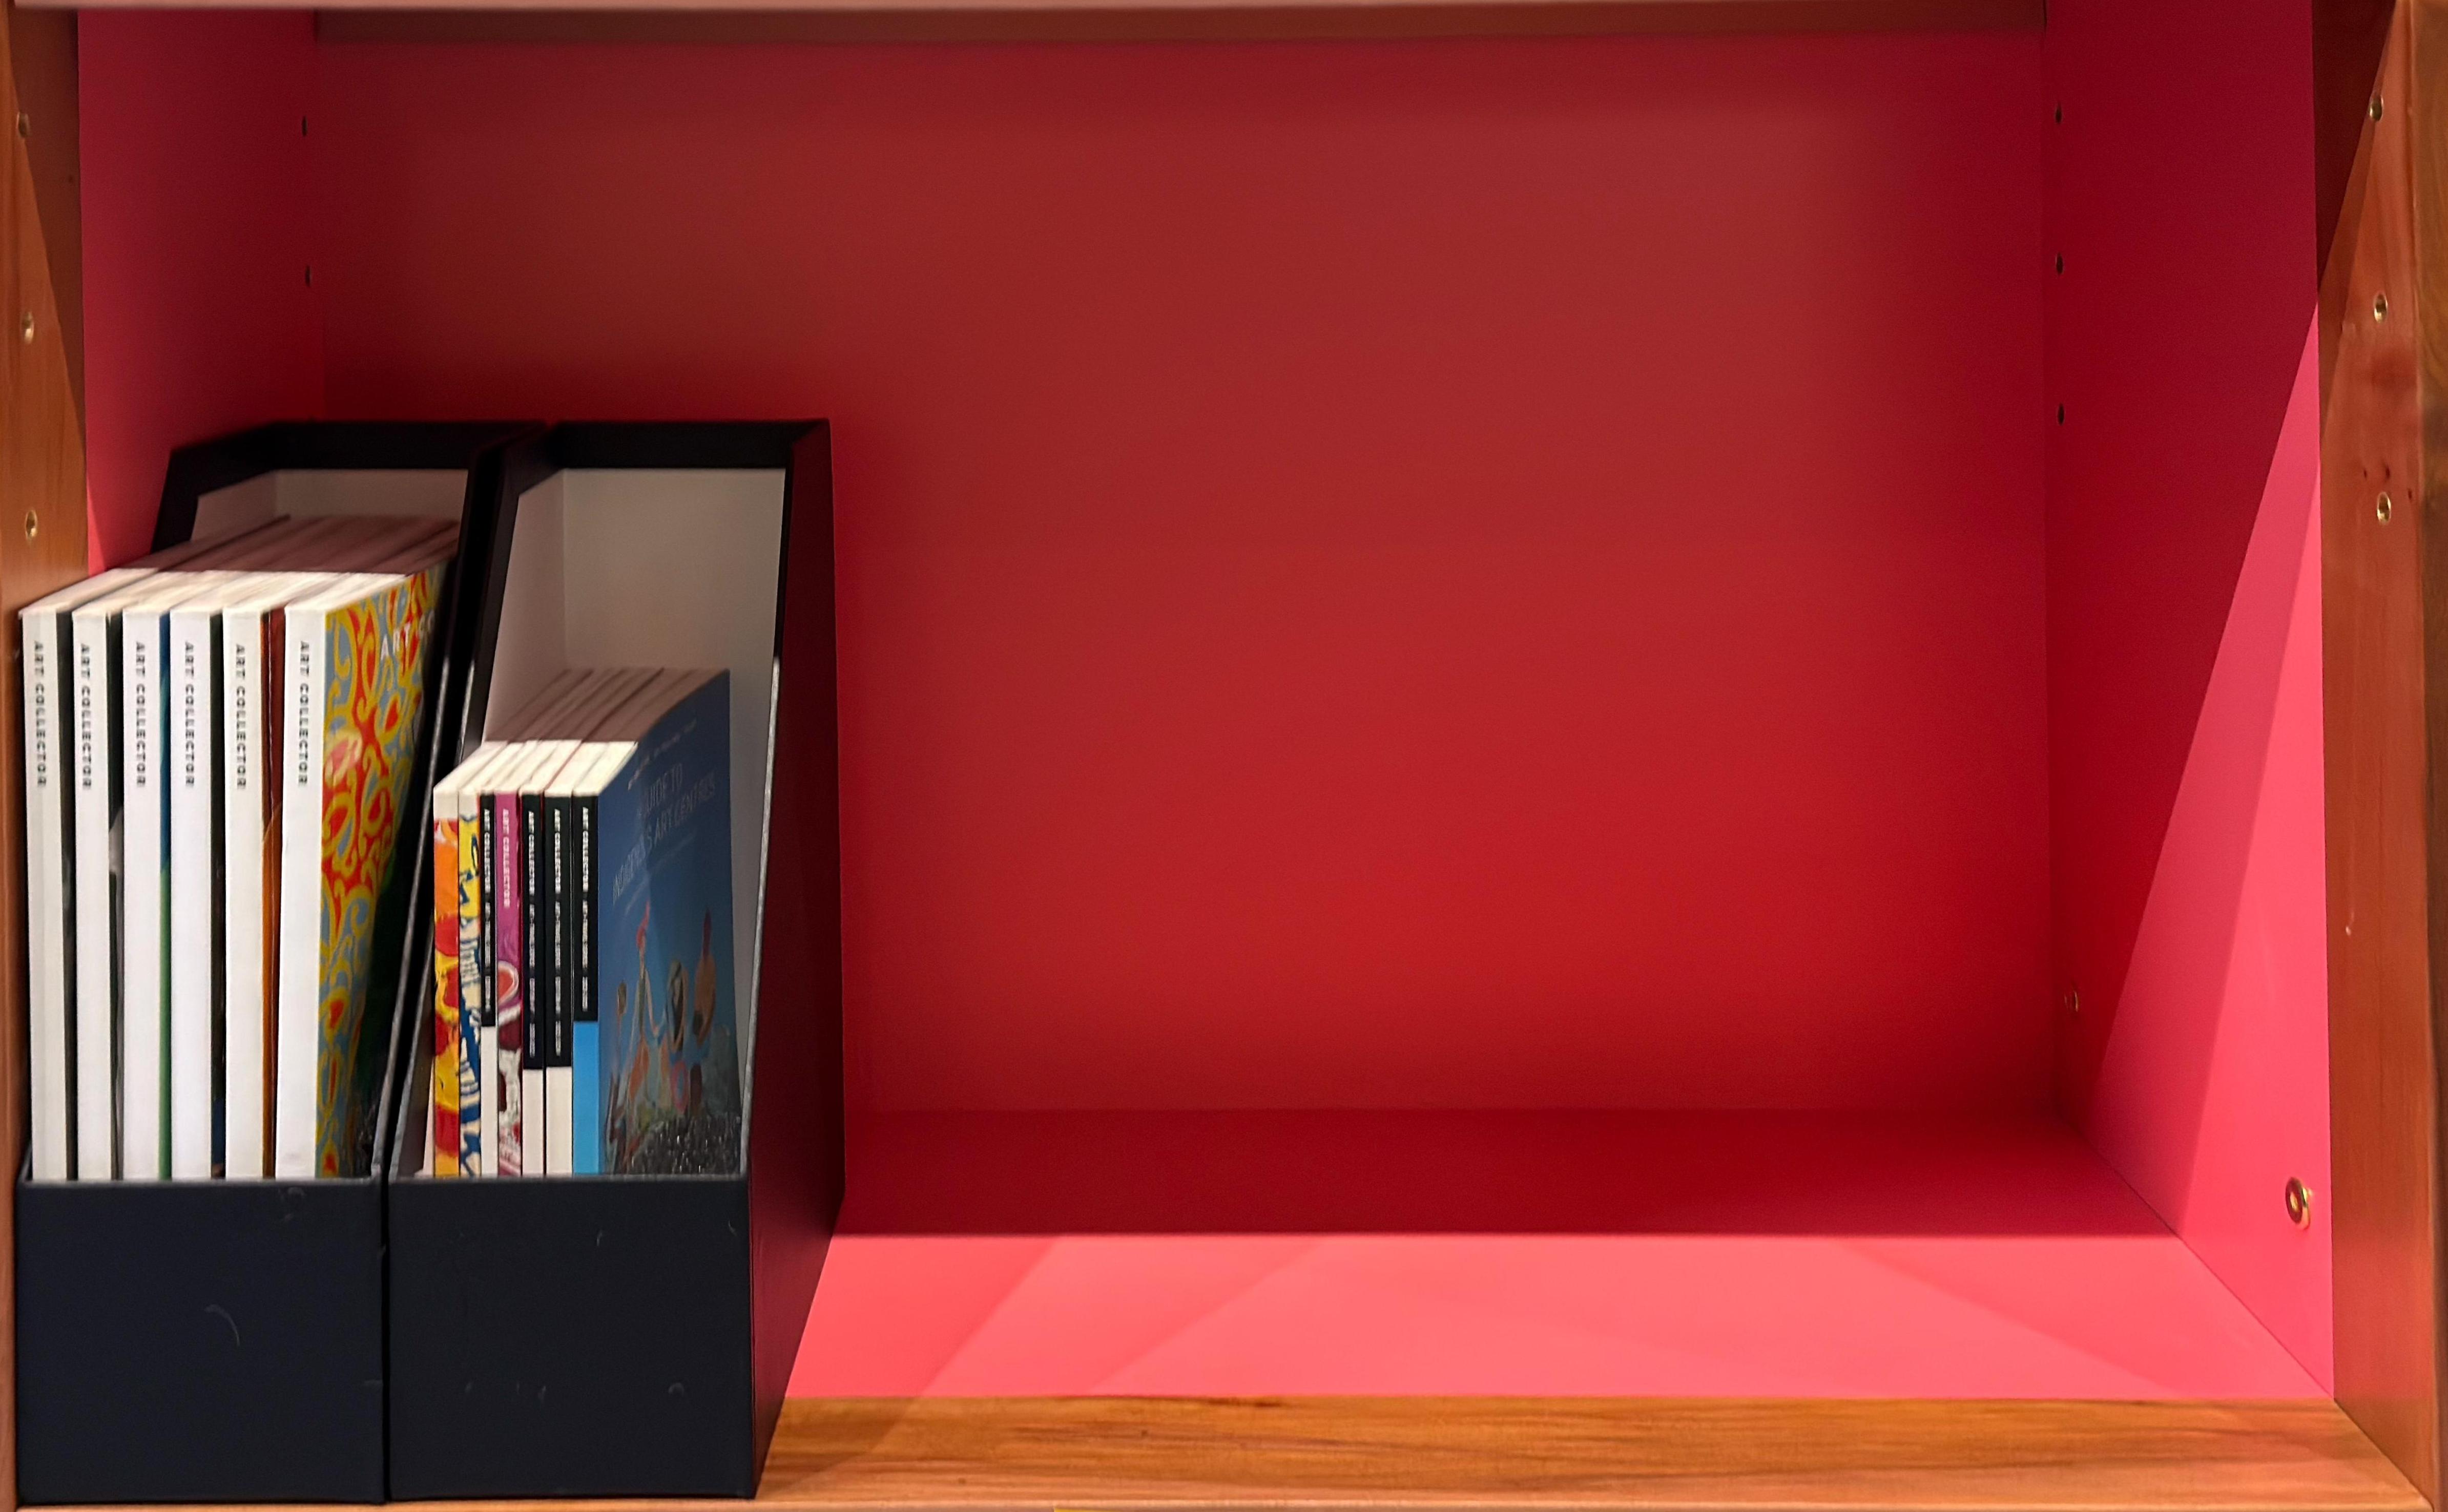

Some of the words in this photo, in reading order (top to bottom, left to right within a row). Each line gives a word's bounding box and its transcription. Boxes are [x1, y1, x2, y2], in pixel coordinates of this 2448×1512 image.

[34, 641, 44, 677] ART
[136, 642, 146, 678] ART
[185, 641, 194, 679] ART
[300, 641, 309, 677] ART
[380, 622, 411, 661] ART
[81, 643, 90, 680] ART
[236, 643, 245, 680] ART
[35, 683, 46, 787] COLLECTOR
[81, 685, 91, 789] COLLECTOR
[136, 683, 146, 787] COLLECTOR
[185, 683, 194, 787] COLLECTOR
[236, 685, 246, 789] COLLECTOR
[298, 683, 309, 788] COLLECTOR
